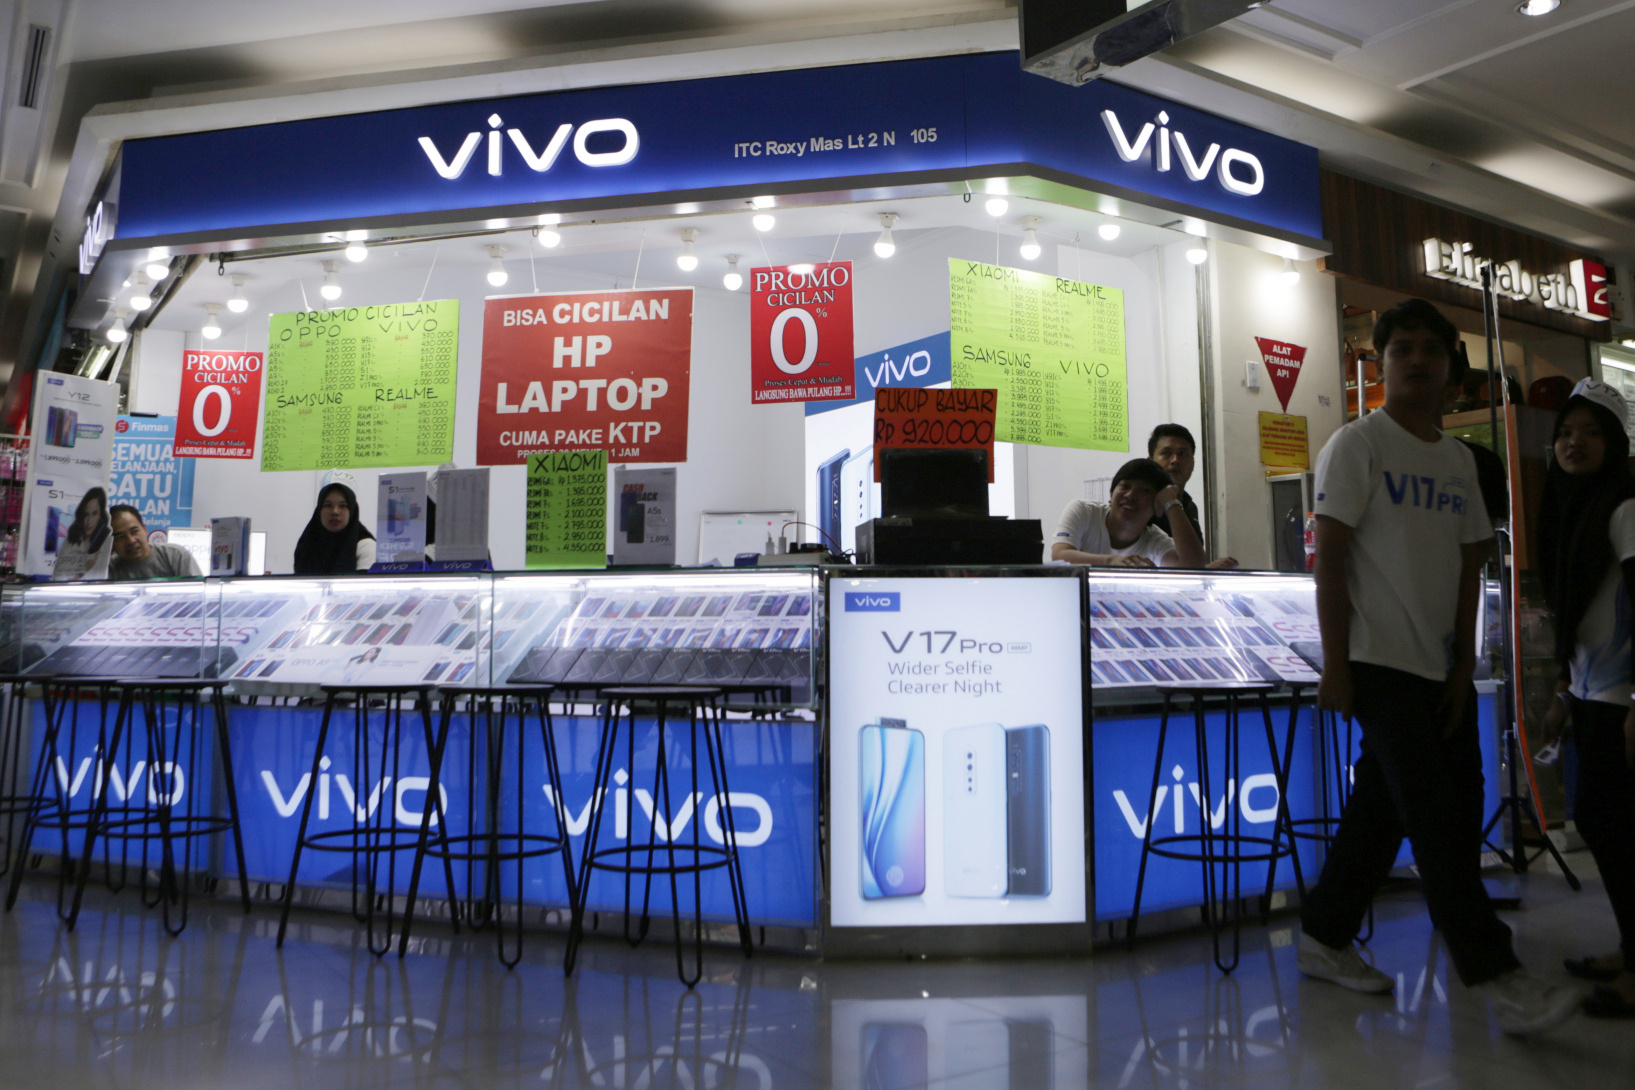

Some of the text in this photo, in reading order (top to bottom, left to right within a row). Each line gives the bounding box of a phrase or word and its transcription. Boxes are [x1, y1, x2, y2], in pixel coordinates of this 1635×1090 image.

[418, 113, 640, 179] vivo
[734, 127, 938, 157] ITC Roxy Mas Lt 2 N 105
[1101, 109, 1264, 196] vivo
[754, 266, 850, 292] PROMO
[966, 262, 1019, 283] XIAOMI
[767, 289, 835, 307] CICILAN
[1056, 278, 1107, 300] REALME
[296, 302, 438, 326] PROMO CICILAN
[503, 299, 669, 326] BISA CICILAN
[280, 324, 341, 342] OPPO
[379, 319, 438, 333] VIVO
[553, 335, 613, 368] HP
[963, 345, 1031, 369] SAMSUNG
[1272, 344, 1292, 356] ALAT
[186, 354, 260, 372] PROMO
[864, 350, 931, 388] vivo
[1059, 360, 1110, 378] VIVO
[1264, 354, 1301, 369] PEMADAM
[194, 372, 248, 383] CICILAN
[1276, 368, 1290, 378] API
[277, 392, 343, 408] SAMSUNG
[375, 387, 438, 403] REALME
[496, 377, 669, 414] LAPTOP
[755, 388, 789, 401] LANGSUNG
[789, 387, 808, 399] BAWA
[808, 386, 833, 398] PULANG
[877, 389, 994, 413] CUKUP BAYAR
[131, 421, 169, 433] Finmas
[500, 421, 662, 446] CUMA PAKE KTP
[902, 419, 993, 445] 920.000
[618, 447, 640, 457] JAM
[111, 460, 177, 475] ELANJAAN,
[48, 489, 65, 499] S1
[1383, 471, 1435, 509] V17
[109, 499, 170, 515] ICILAN
[855, 595, 891, 607] vivo
[959, 638, 1003, 654] Pro
[888, 660, 993, 676] Wider Selfie
[888, 679, 1003, 697] Clearer Night
[57, 743, 185, 806] vivo
[260, 754, 448, 827] vivo
[543, 767, 774, 848] vivo
[1112, 764, 1281, 840] vivo
